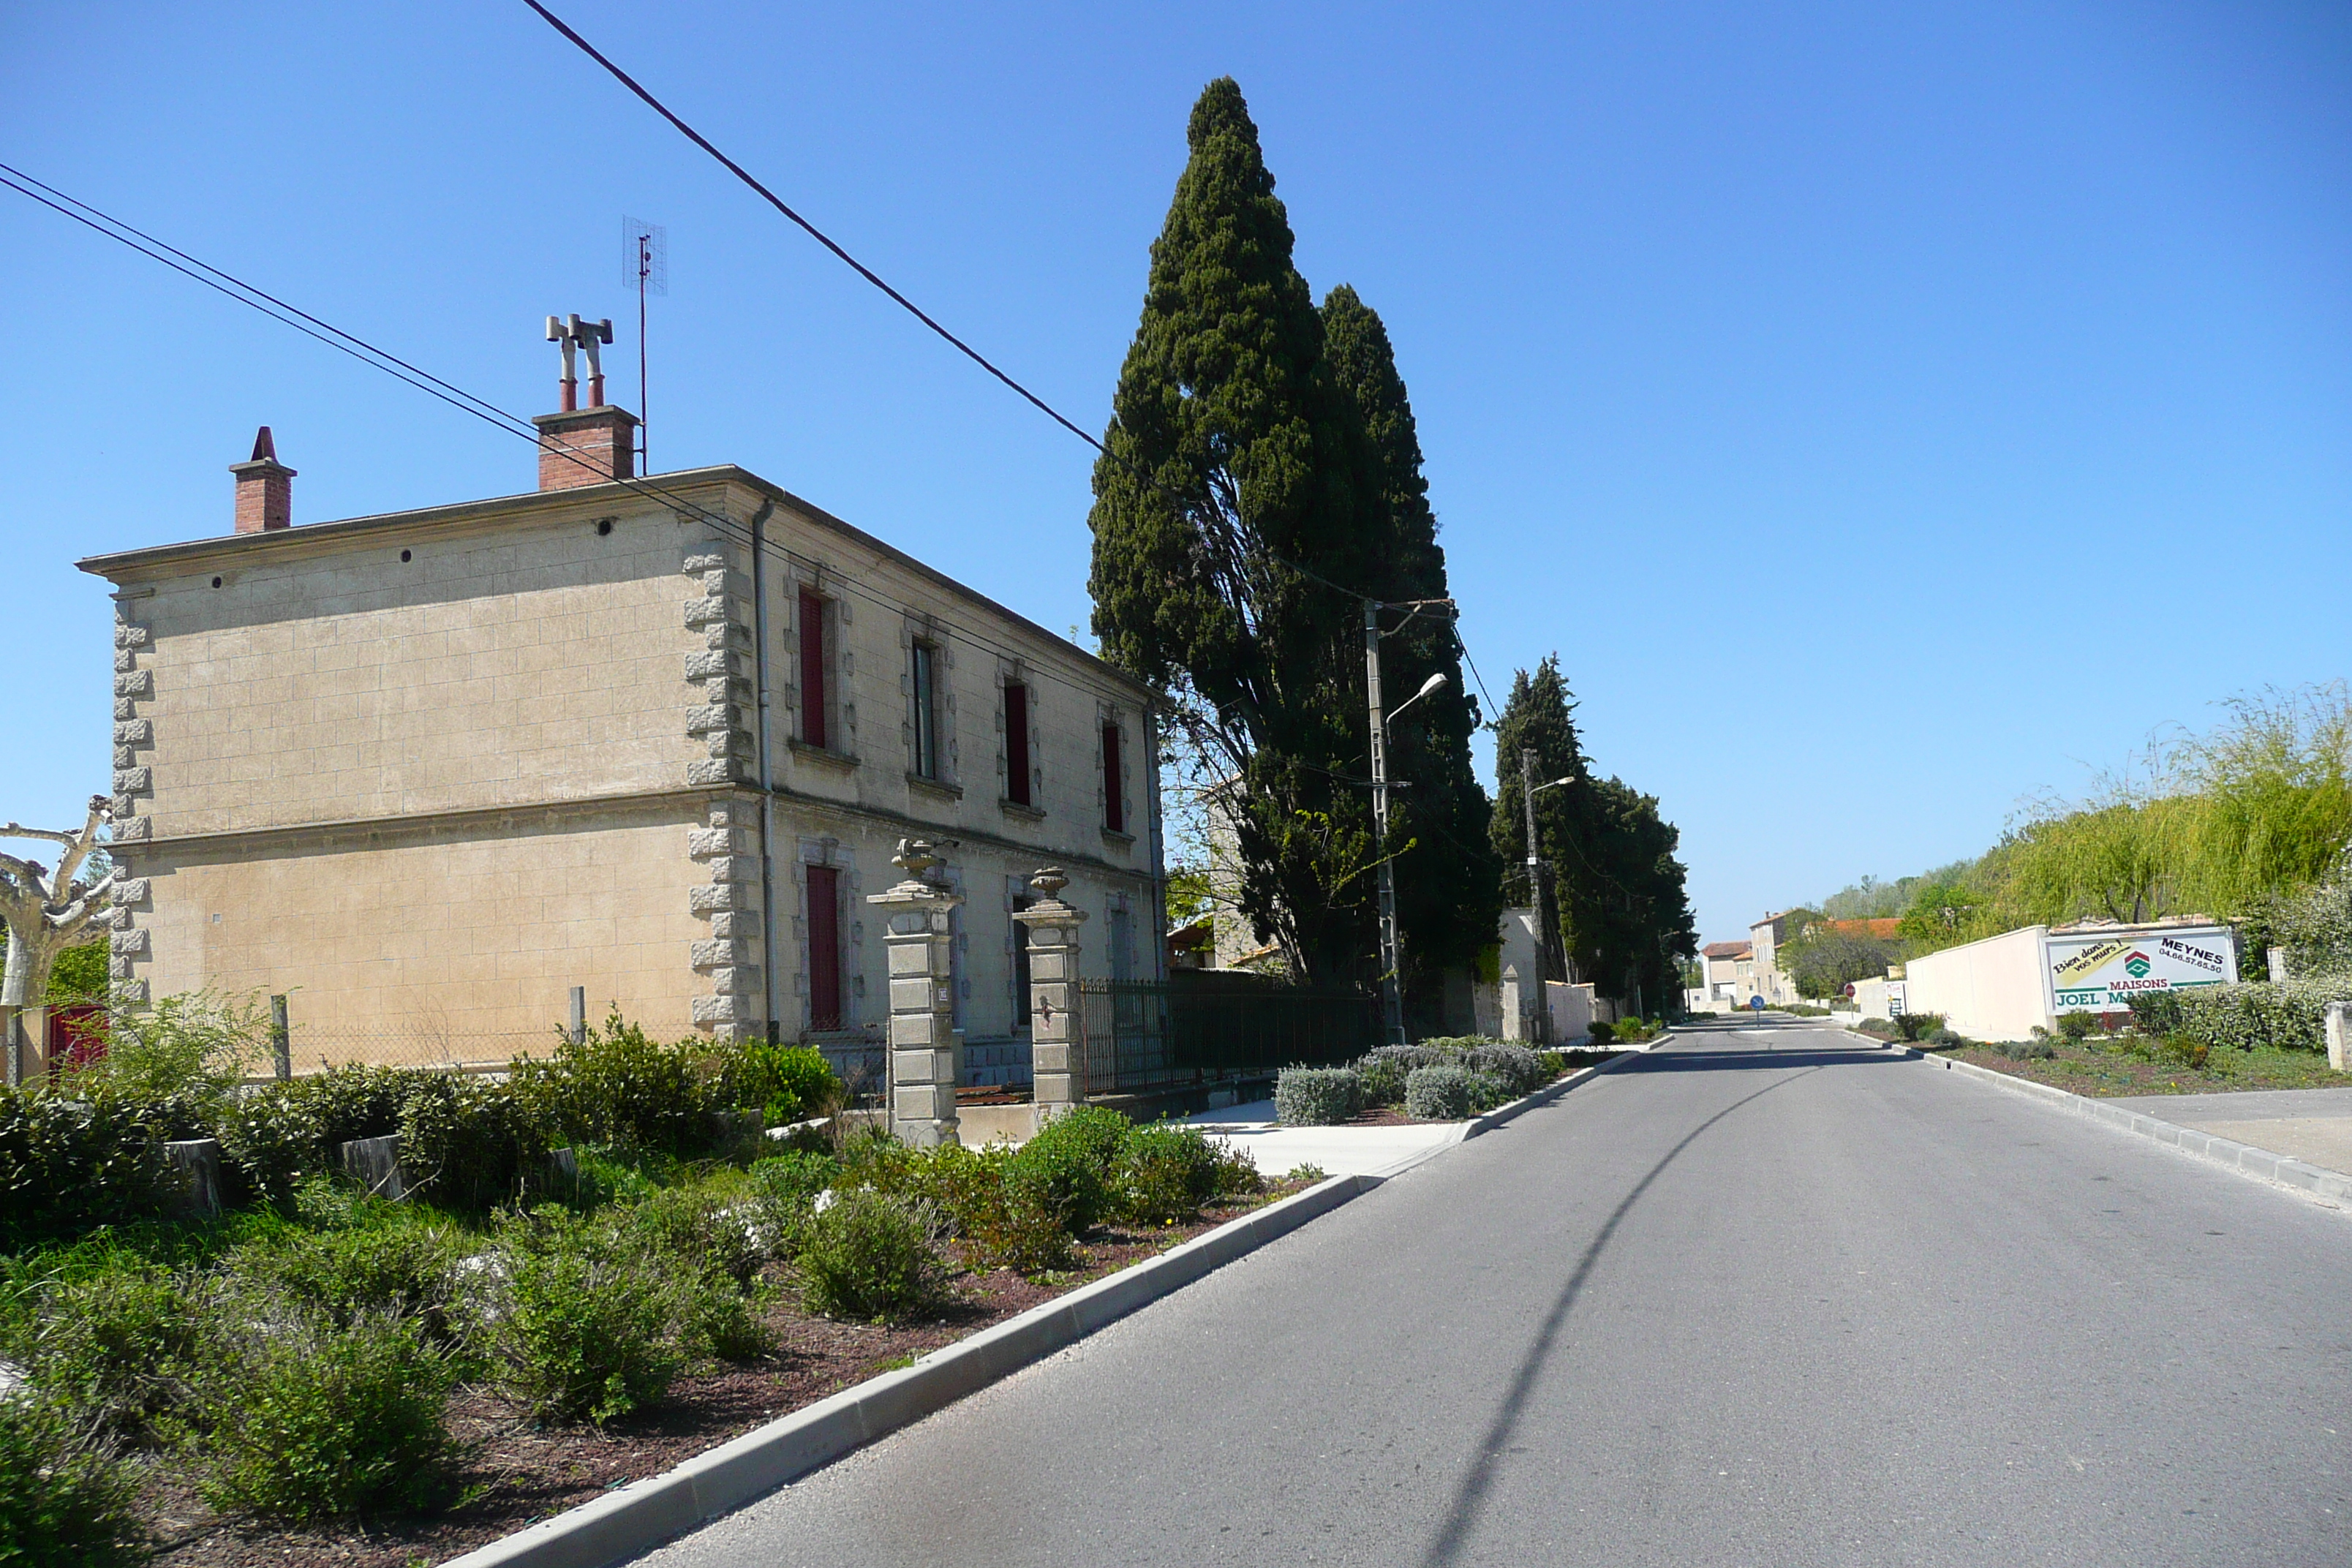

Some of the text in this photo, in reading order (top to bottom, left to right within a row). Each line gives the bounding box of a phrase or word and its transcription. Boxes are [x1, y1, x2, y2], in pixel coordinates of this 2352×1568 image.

[2053, 941, 2104, 974] Bien dans
[2073, 960, 2091, 972] vos
[2091, 945, 2117, 962] murs
[2159, 948, 2222, 973] 04.66.57.65.50
[2161, 938, 2224, 965] MEYNES
[2109, 979, 2168, 991] MAISONS
[2057, 993, 2100, 1006] JOEL
